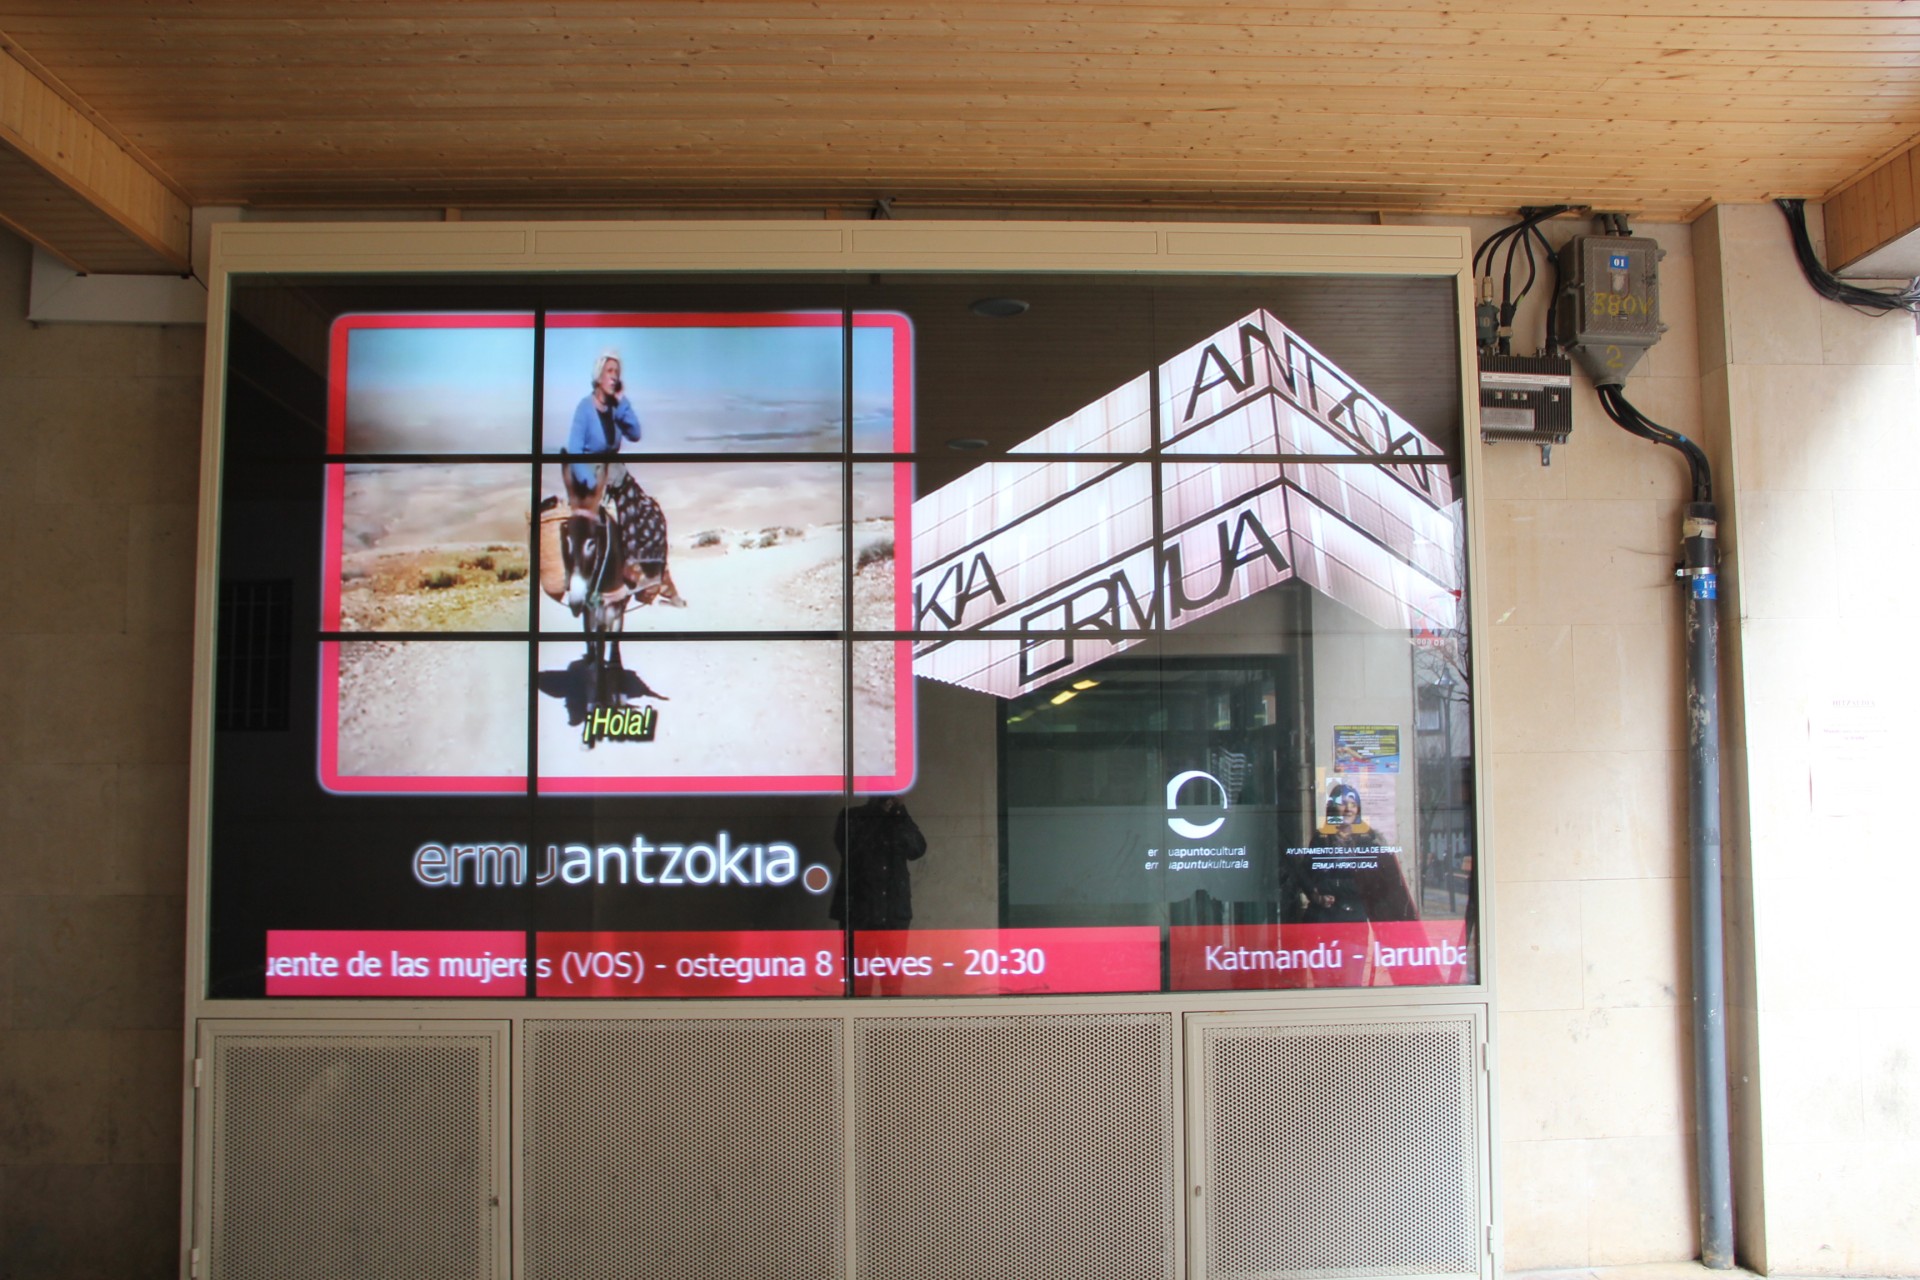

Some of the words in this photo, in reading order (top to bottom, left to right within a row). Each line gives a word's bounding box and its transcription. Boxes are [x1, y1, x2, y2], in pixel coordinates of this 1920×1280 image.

[1613, 258, 1625, 267] 01
[1606, 344, 1625, 368] 2
[1019, 509, 1291, 687] ERMUA
[584, 707, 652, 742] ¡Hola!
[1147, 846, 1247, 858] eruapuntocultural
[346, 950, 381, 977] de
[391, 950, 429, 977] las
[562, 951, 645, 984] (VOS)
[676, 952, 806, 982] osteguna
[815, 950, 834, 976] 8
[840, 955, 932, 982] ueves
[964, 948, 1046, 976] 20:30
[1205, 940, 1343, 971] Katmandú
[1374, 940, 1467, 968] larunba
